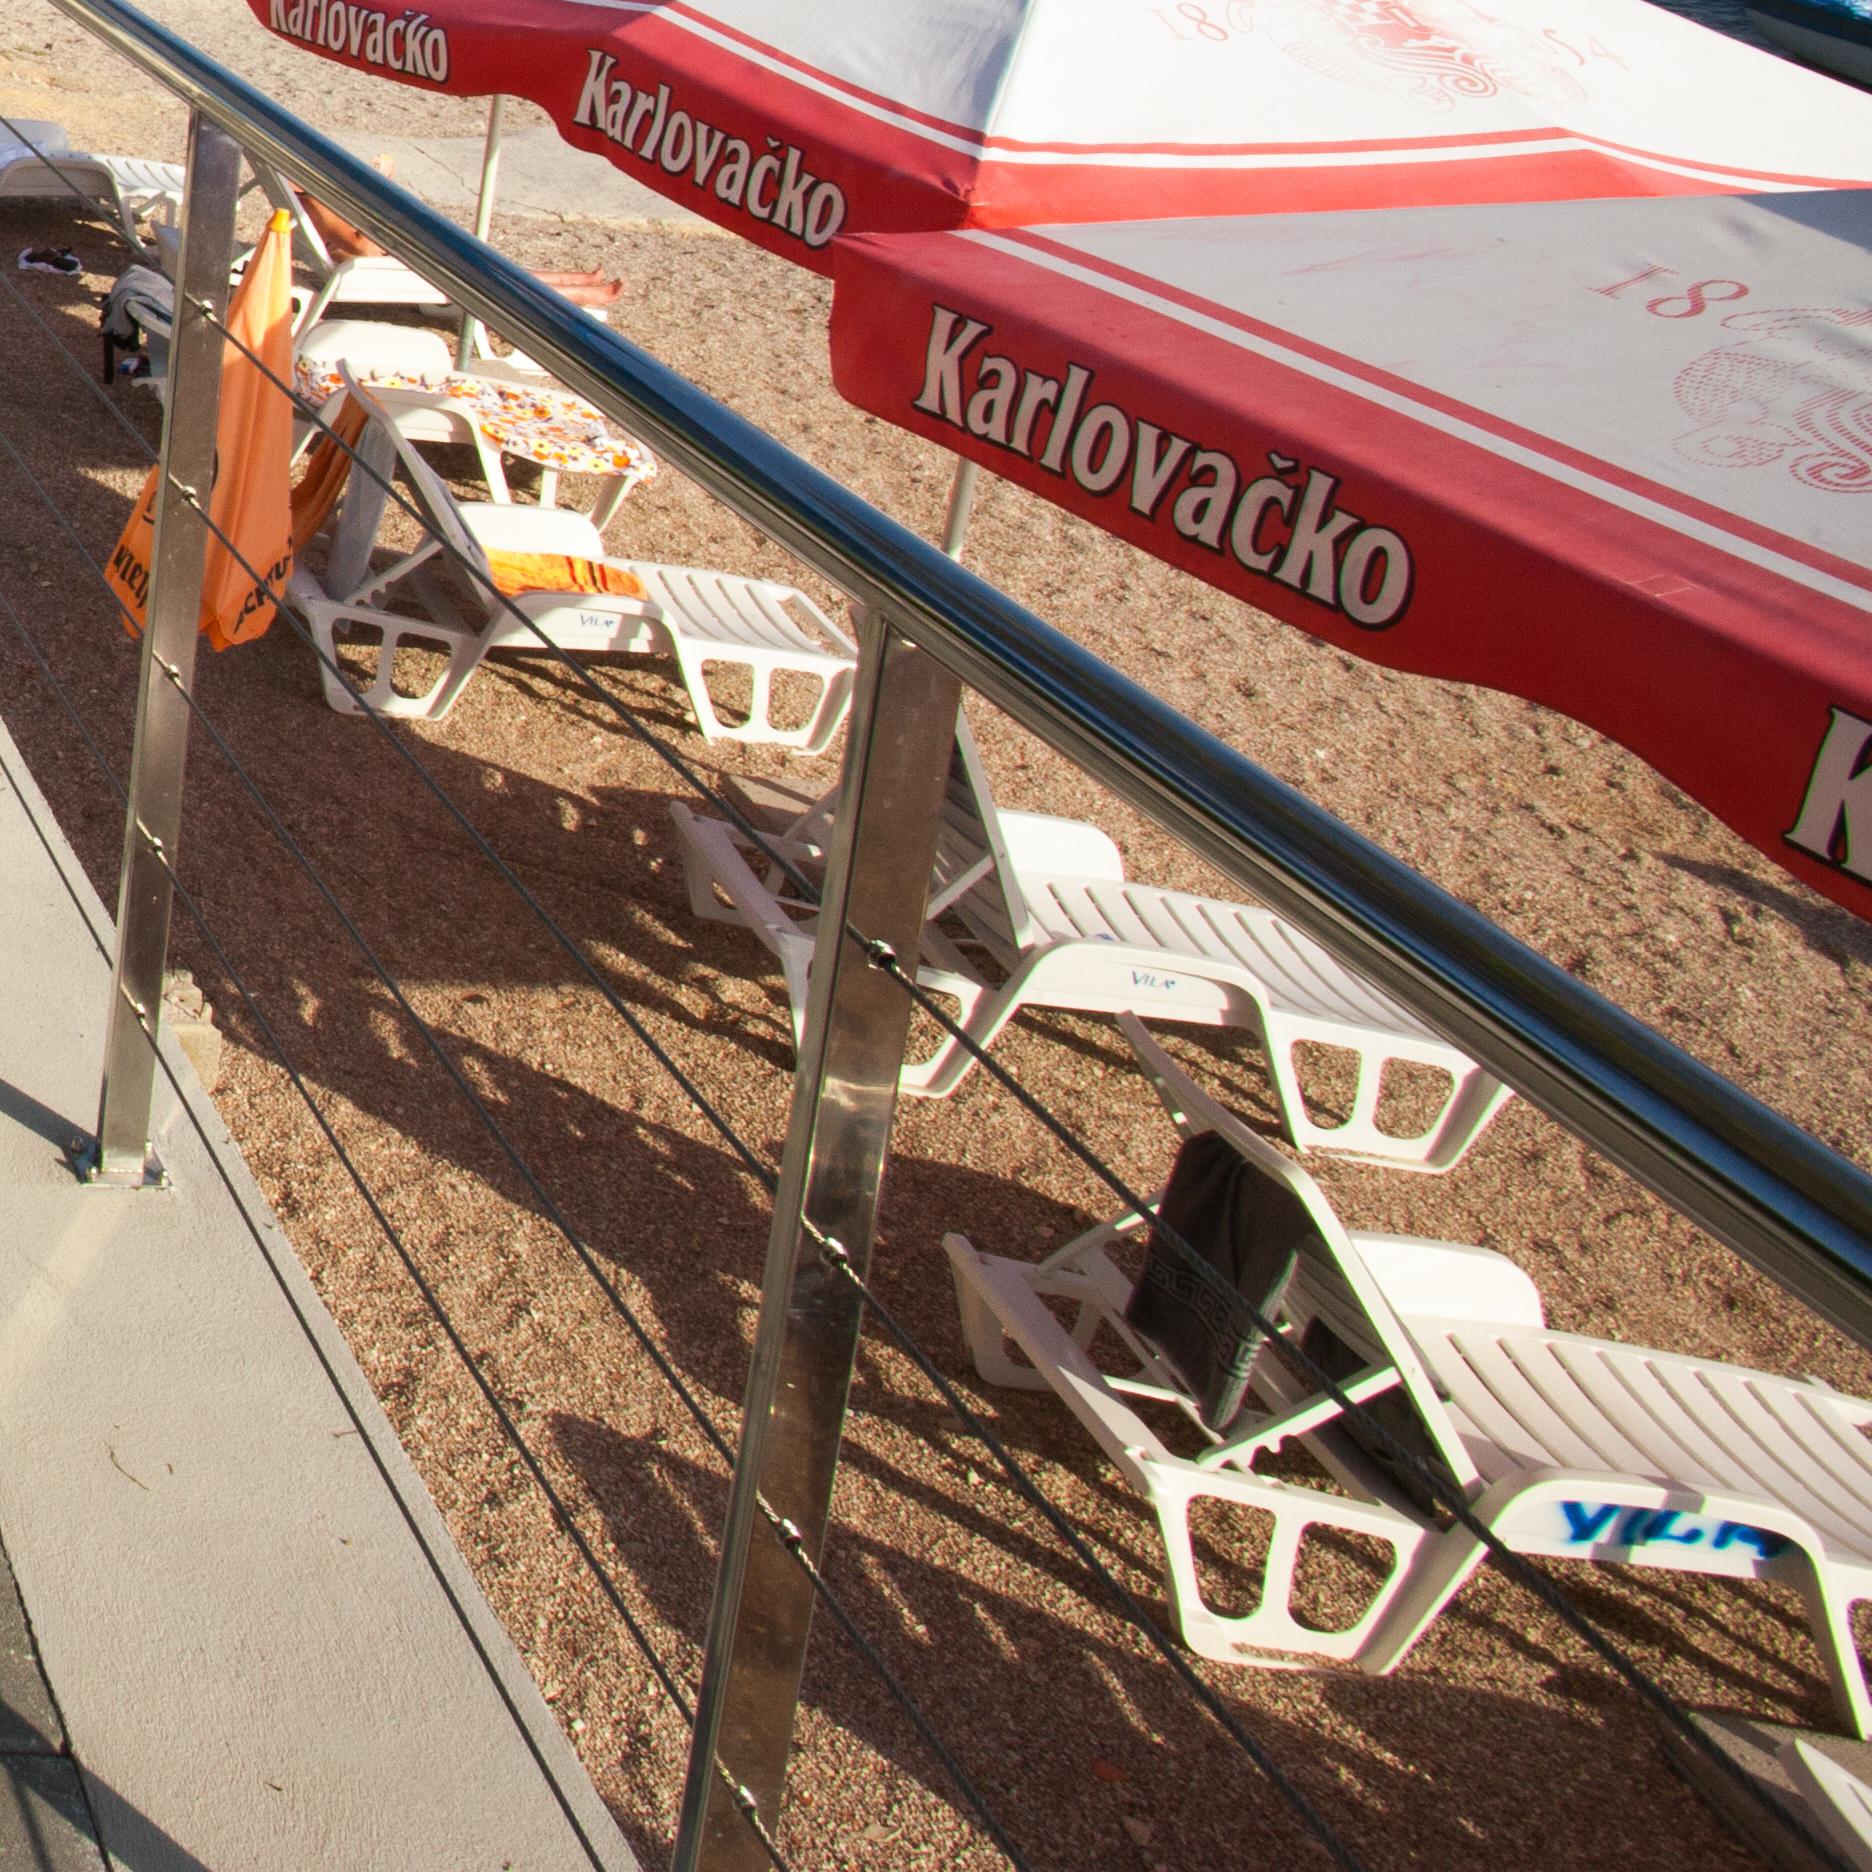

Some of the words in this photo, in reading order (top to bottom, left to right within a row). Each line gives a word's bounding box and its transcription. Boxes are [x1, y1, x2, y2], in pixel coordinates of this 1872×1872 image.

[570, 47, 849, 251] Karlovačko
[1584, 262, 1751, 319] 18
[911, 302, 1416, 630] Karlovačko
[1559, 1501, 1796, 1561] VILA
